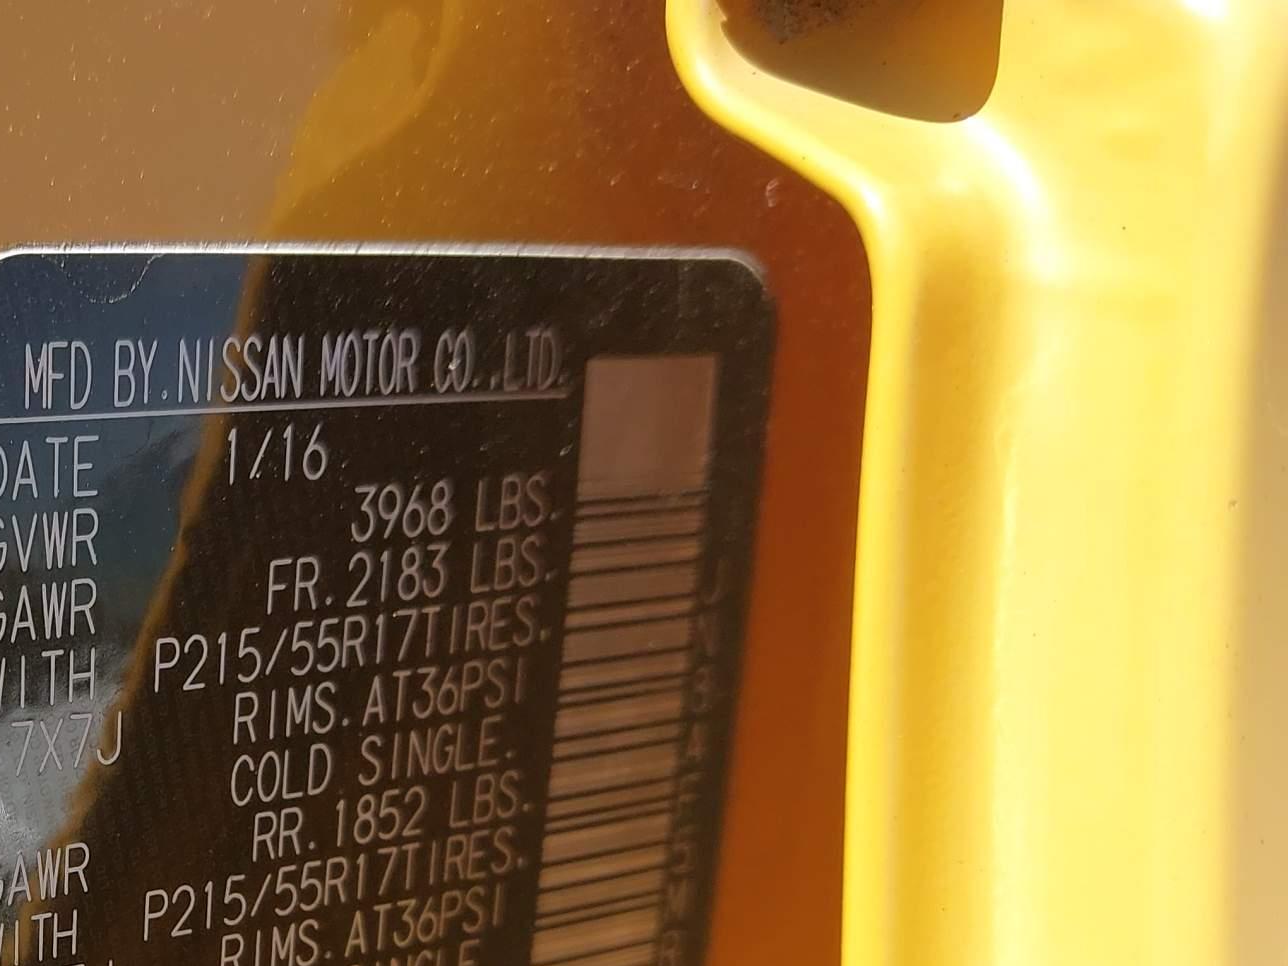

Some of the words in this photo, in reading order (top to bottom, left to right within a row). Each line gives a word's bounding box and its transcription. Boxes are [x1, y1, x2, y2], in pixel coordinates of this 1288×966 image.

[24, 340, 92, 410] MFD
[320, 327, 420, 397] MOTOR
[228, 422, 328, 485] 1/16
[351, 479, 454, 542] 3968
[475, 474, 559, 532] LBS.
[470, 536, 553, 593] LBS.
[230, 743, 332, 807] COLD
[358, 715, 517, 786] SINGLE.
[449, 770, 532, 828] LBS.
